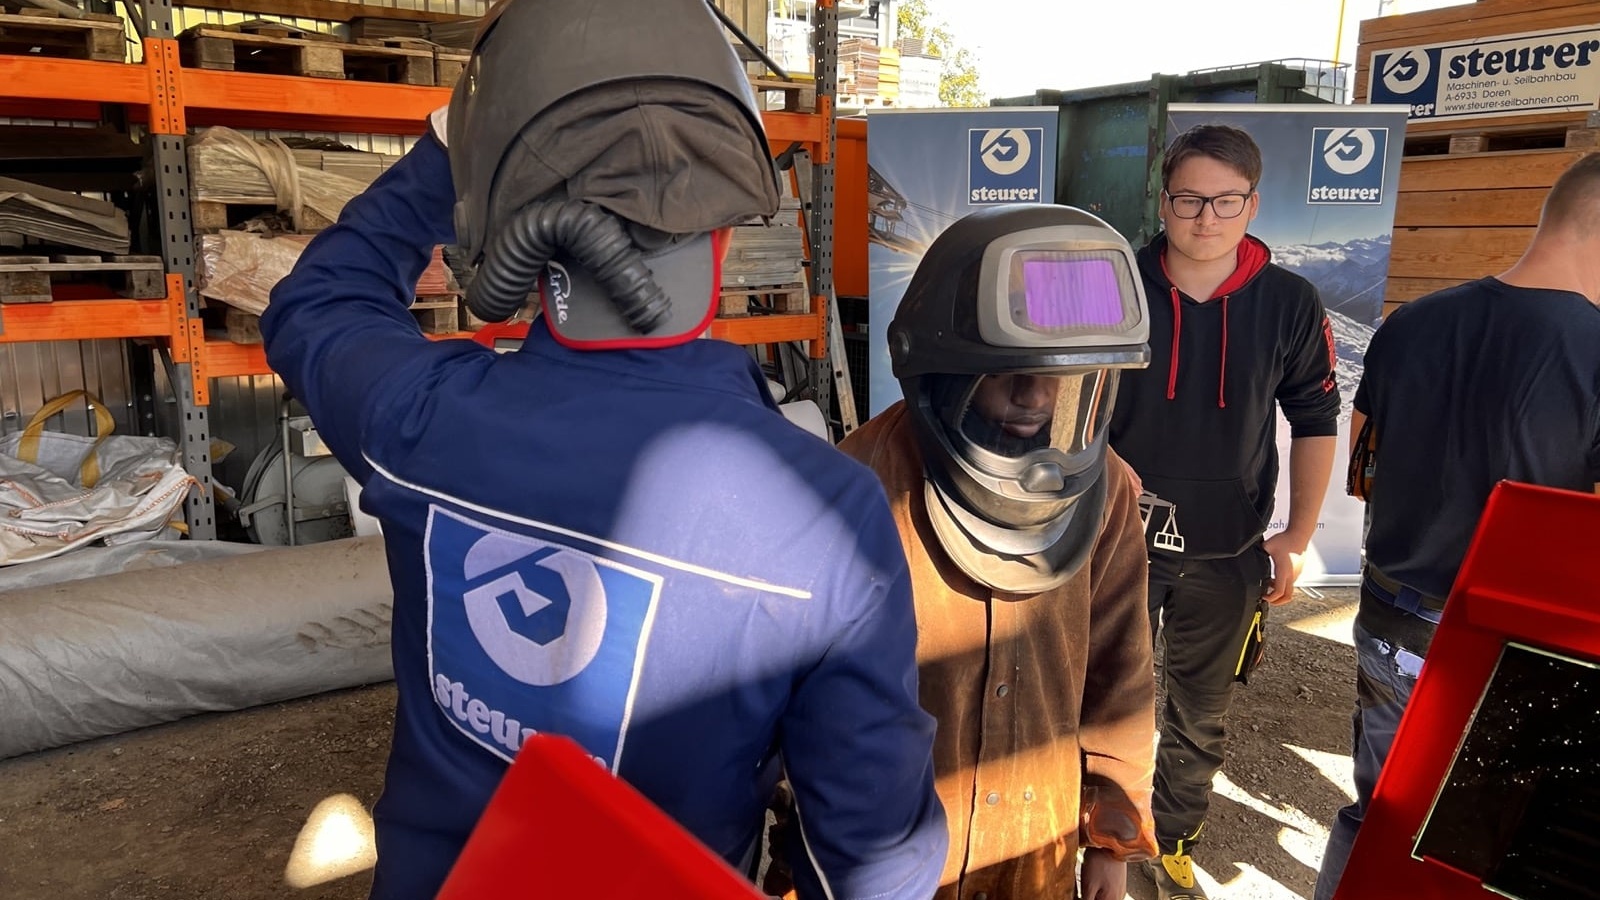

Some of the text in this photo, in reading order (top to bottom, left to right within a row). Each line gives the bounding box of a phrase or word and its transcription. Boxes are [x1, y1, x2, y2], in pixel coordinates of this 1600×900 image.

[1448, 39, 1600, 79] steurer
[1446, 80, 1500, 91] Maschinen-
[1514, 72, 1577, 85] Seilbahnbau
[1444, 94, 1580, 110] www.steurer-seilbahnen.com
[1445, 89, 1511, 101] A-6933 Doren
[971, 186, 1038, 201] steurer
[1310, 185, 1379, 200] steurer
